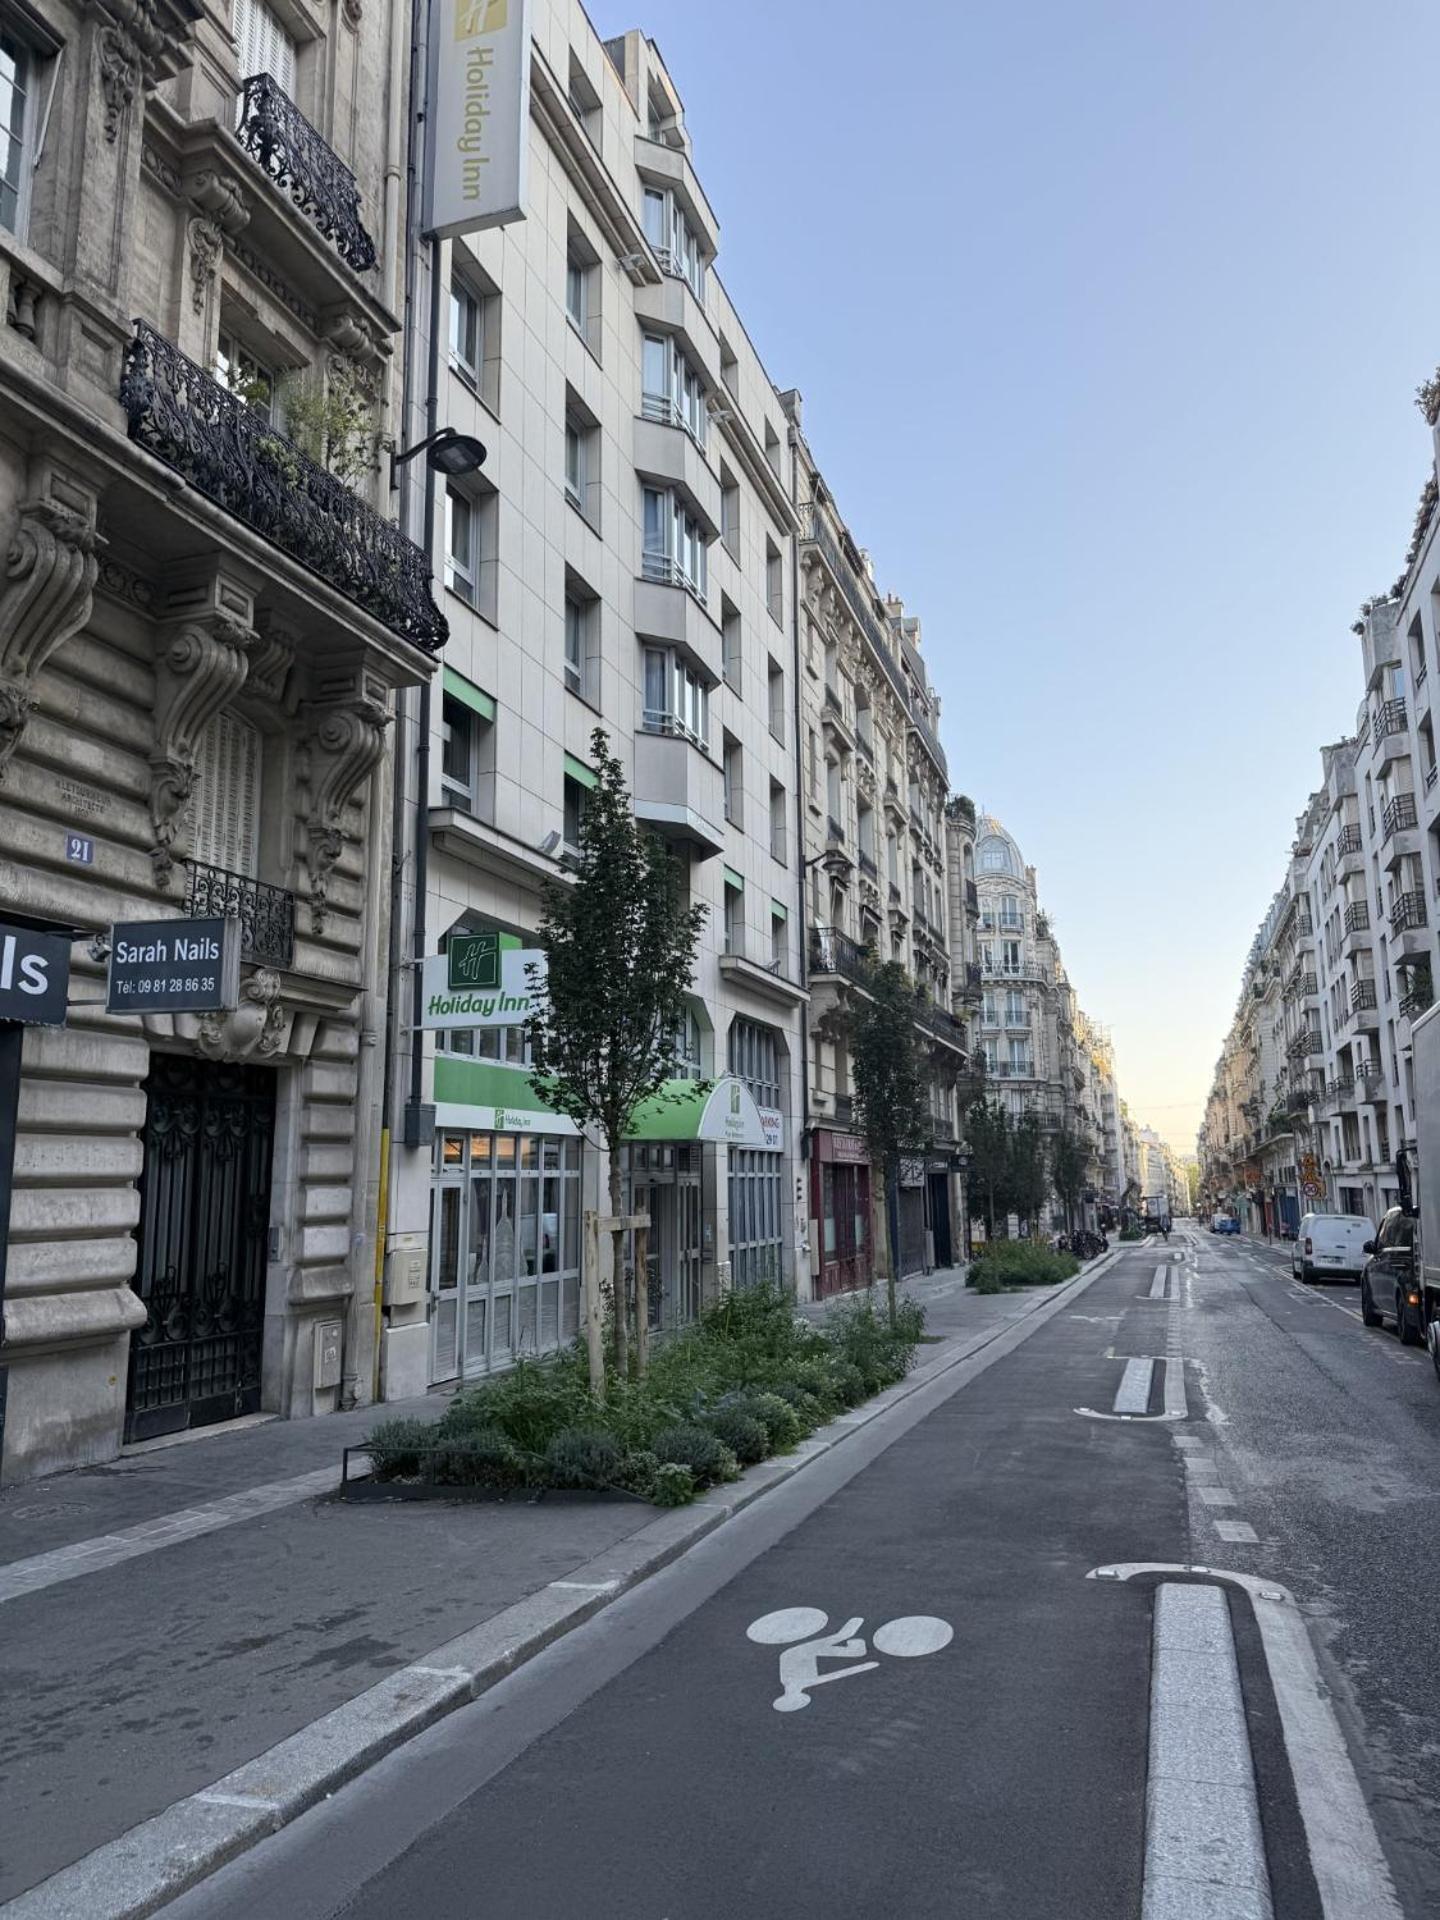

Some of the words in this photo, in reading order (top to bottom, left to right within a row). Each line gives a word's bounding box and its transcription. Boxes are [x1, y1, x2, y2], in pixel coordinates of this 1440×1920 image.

[457, 47, 494, 152] Holiday
[463, 157, 490, 201] Inn
[71, 838, 89, 861] 21
[116, 940, 167, 964] Sarah
[174, 937, 219, 961] Nails
[138, 979, 152, 993] 09
[153, 979, 166, 993] 81
[169, 978, 183, 993] 28
[185, 977, 199, 992] 86
[201, 977, 215, 992] 35
[428, 993, 496, 1017] Holiday
[499, 991, 530, 1012] Inn
